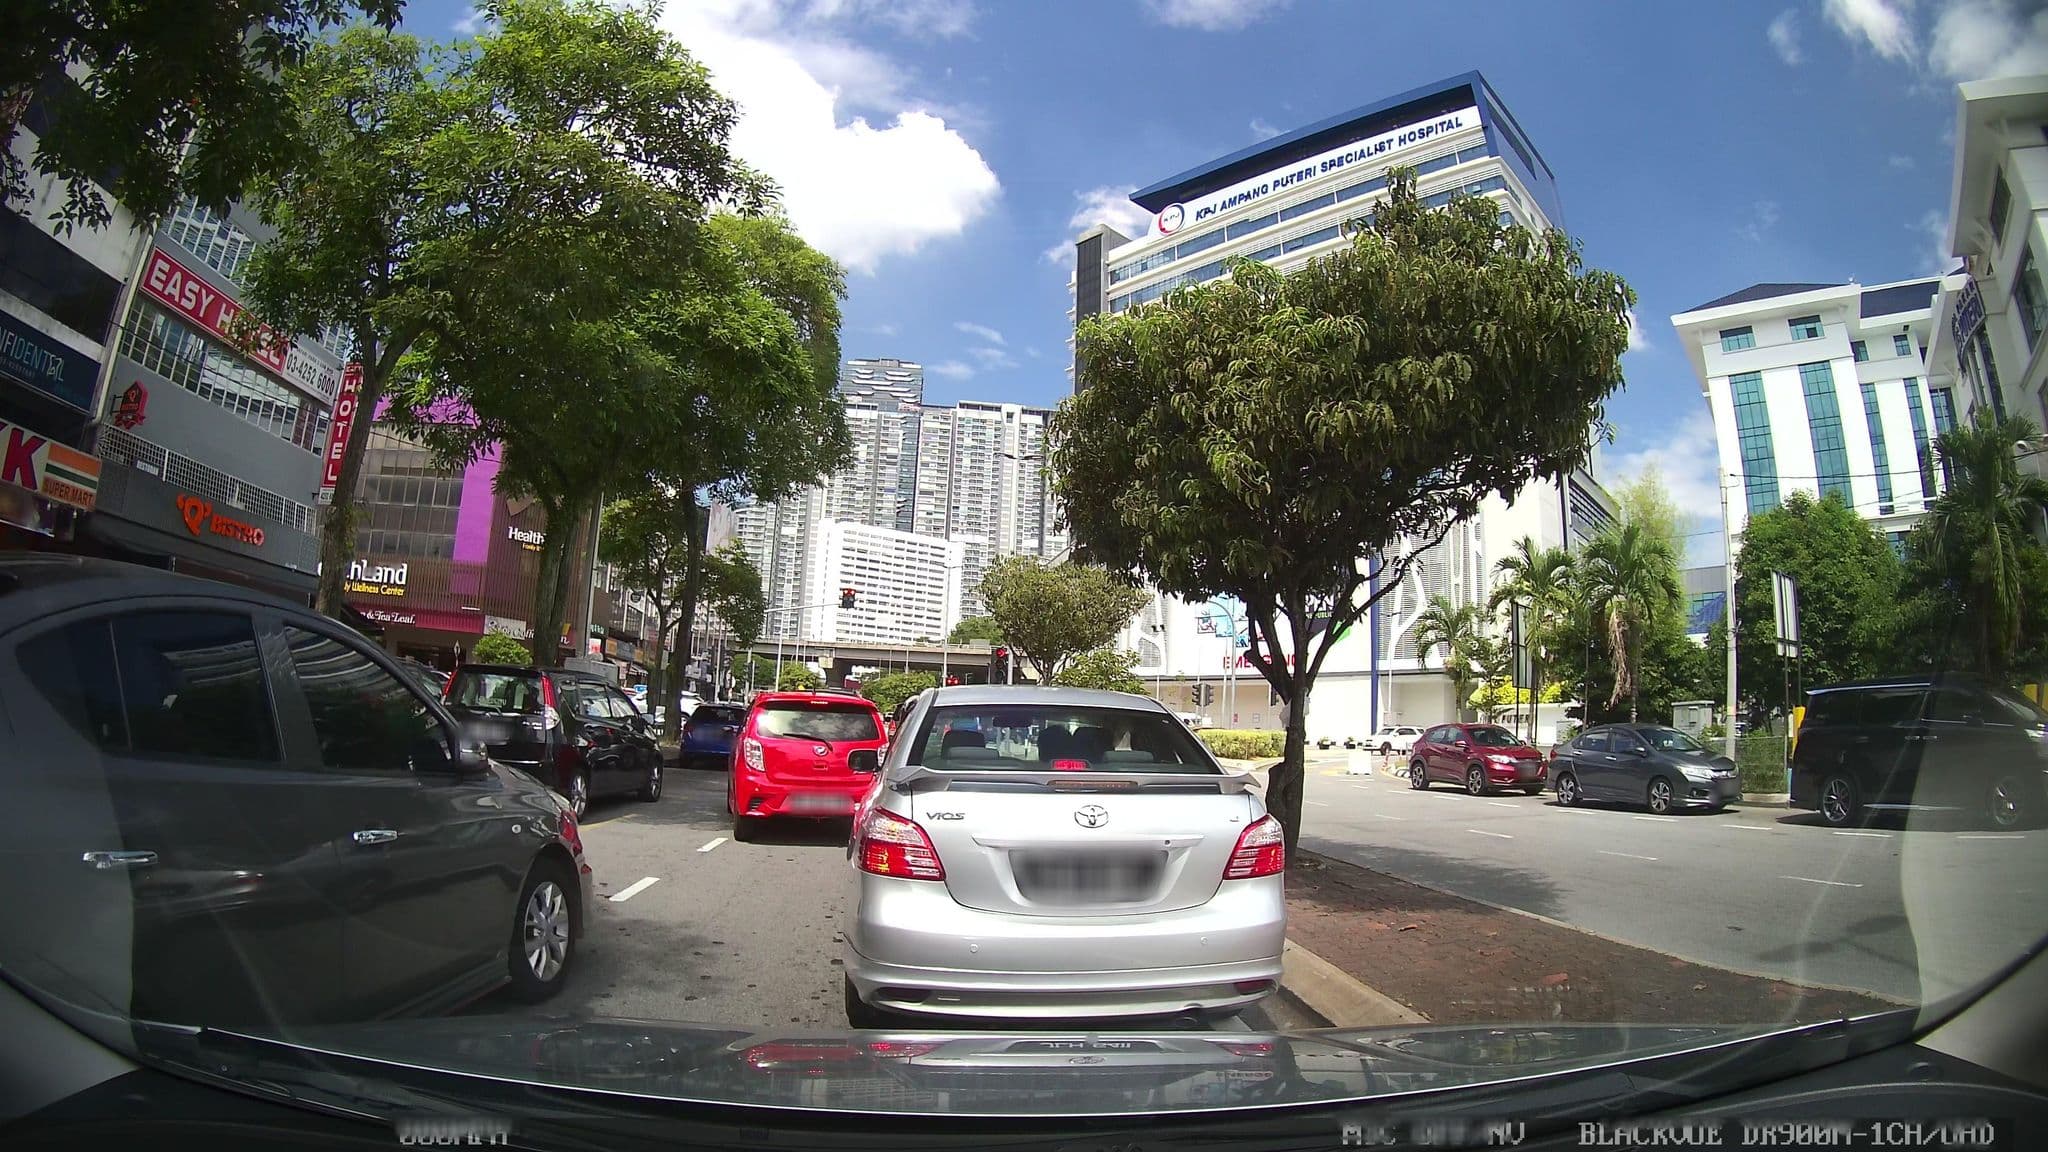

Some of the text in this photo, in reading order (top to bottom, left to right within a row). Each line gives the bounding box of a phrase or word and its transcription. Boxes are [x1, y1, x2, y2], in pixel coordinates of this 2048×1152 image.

[1195, 116, 1463, 222] KPJ AMPANG PUTERI SPECIALIST HOSPITAL
[149, 258, 215, 318] EASY
[317, 372, 336, 397] 6000
[327, 379, 357, 482] HOTEL
[210, 514, 265, 547] BISTRO
[380, 584, 405, 596] Center
[926, 811, 966, 821] VIOS
